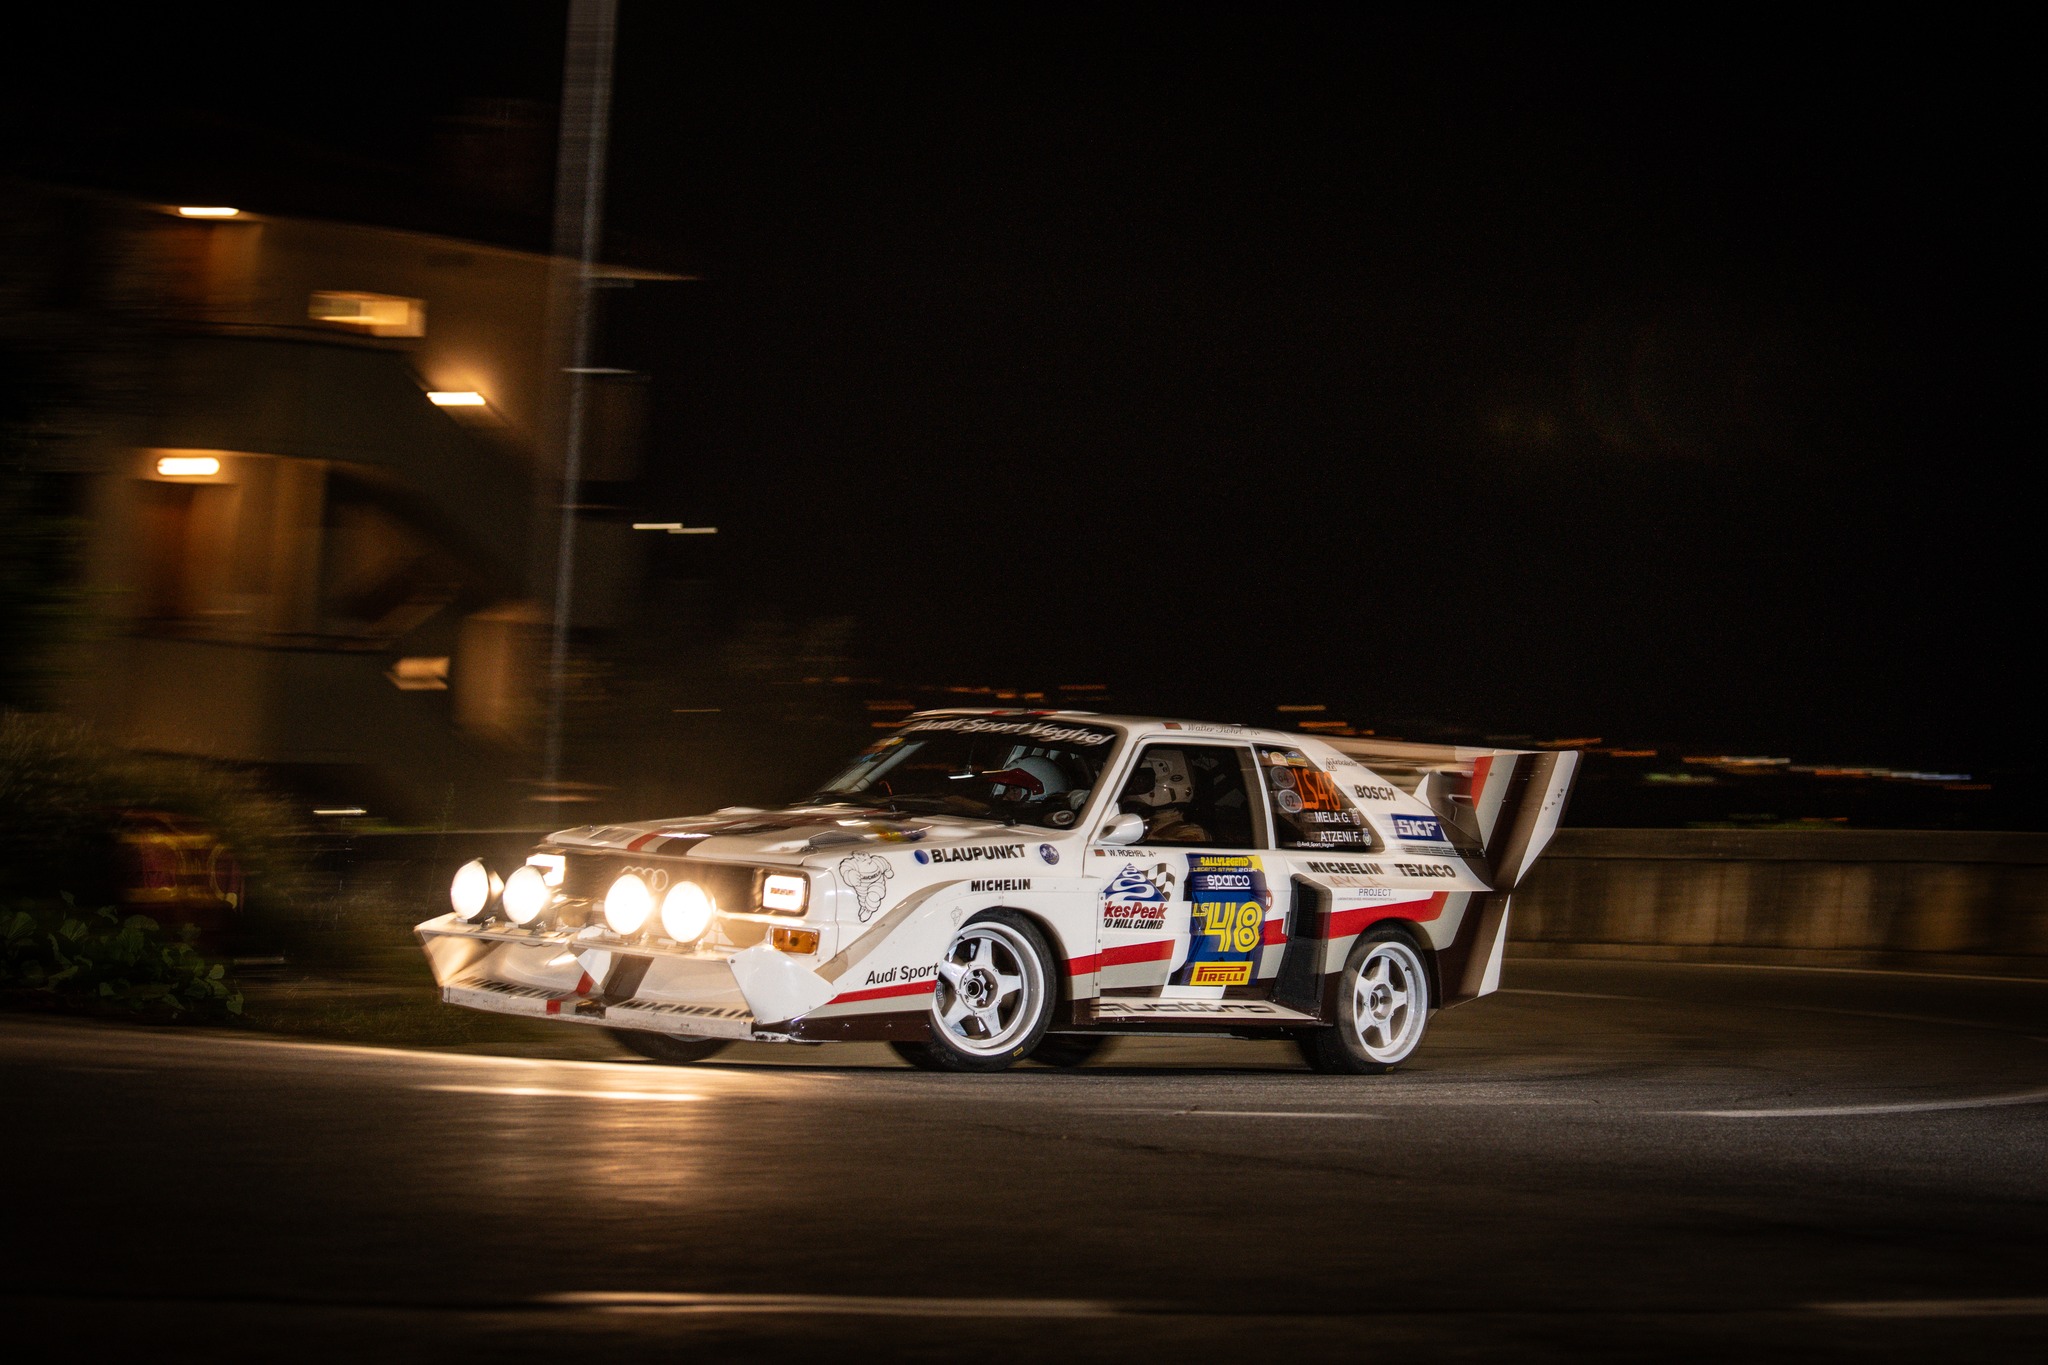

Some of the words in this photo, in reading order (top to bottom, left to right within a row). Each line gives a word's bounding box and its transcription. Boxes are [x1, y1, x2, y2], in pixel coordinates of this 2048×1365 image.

[914, 718, 964, 731] Audi
[961, 719, 1029, 734] Sport
[1026, 722, 1116, 746] Veghel
[1292, 767, 1341, 811] LS48
[1354, 785, 1396, 801] BOSCH
[1285, 795, 1296, 807] 62
[1315, 811, 1340, 823] MELA
[1341, 812, 1351, 823] G.
[1396, 819, 1437, 837] SKF
[1320, 831, 1352, 842] ATZENI
[1352, 831, 1362, 842] F.
[930, 843, 1026, 864] BLAUPUNKT
[1200, 856, 1249, 867] RALLYLEGEND
[1306, 861, 1384, 875] MICHELIN
[1394, 863, 1457, 878] TEXACO
[970, 878, 1031, 892] MICHELIN
[1207, 874, 1250, 890] sparco
[1358, 888, 1392, 897] PROJECT
[1113, 918, 1135, 929] HILL
[1134, 918, 1164, 930] CLIMB
[865, 967, 898, 985] Audi
[900, 962, 938, 982] Sport
[1196, 966, 1247, 982] PIRELLI
